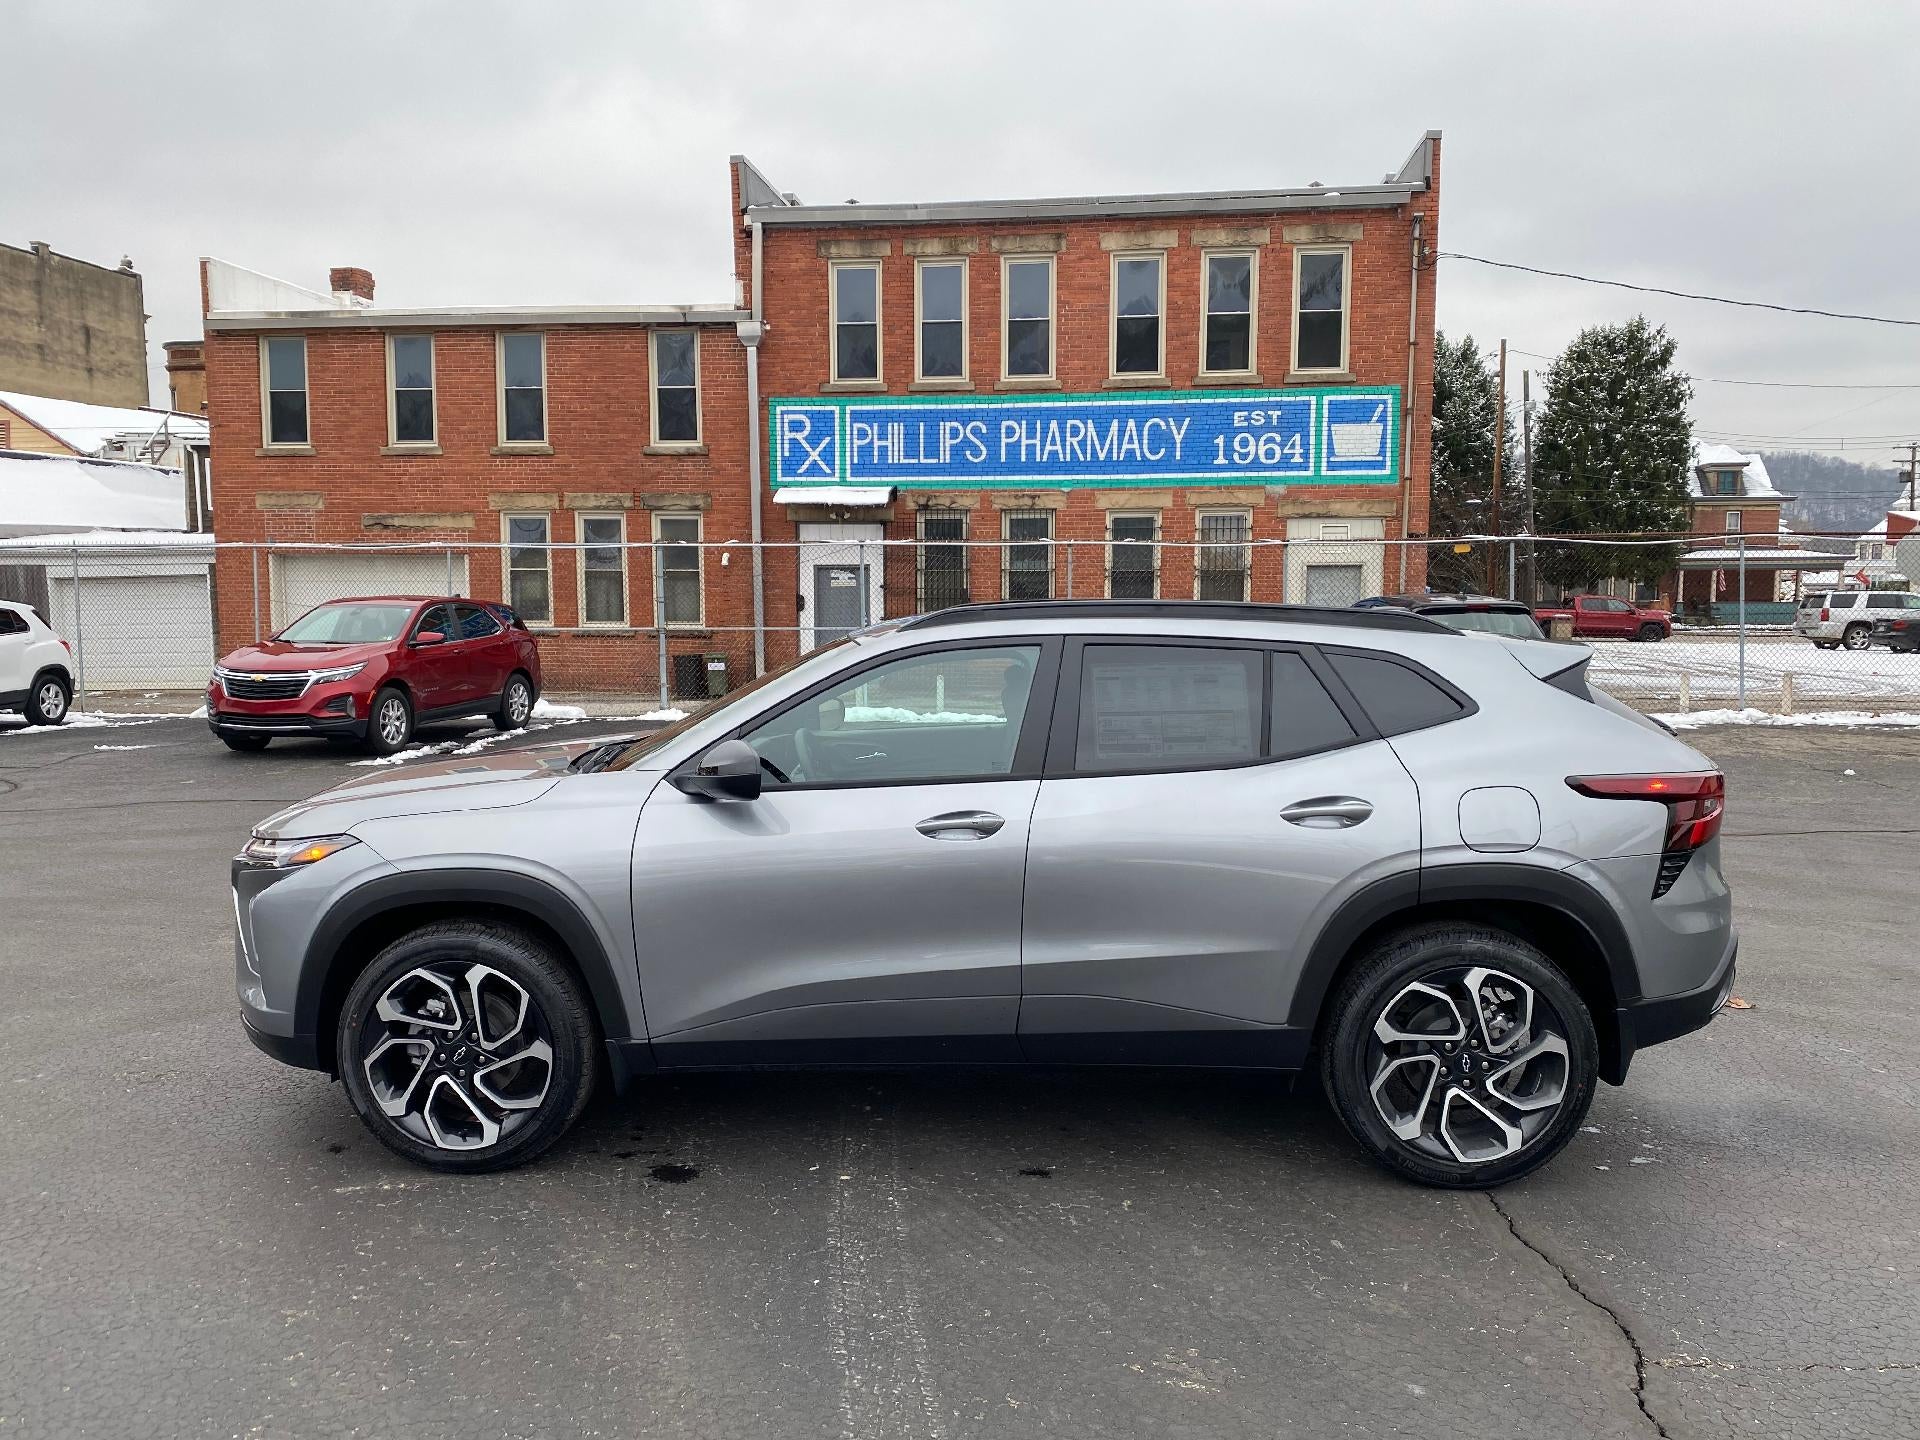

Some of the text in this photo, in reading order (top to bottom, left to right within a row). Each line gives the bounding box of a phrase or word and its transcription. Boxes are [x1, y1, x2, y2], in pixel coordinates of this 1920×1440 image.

[1232, 409, 1282, 427] EST
[852, 416, 1191, 464] PHILLIPS PHARMACY
[1212, 431, 1304, 465] 1964
